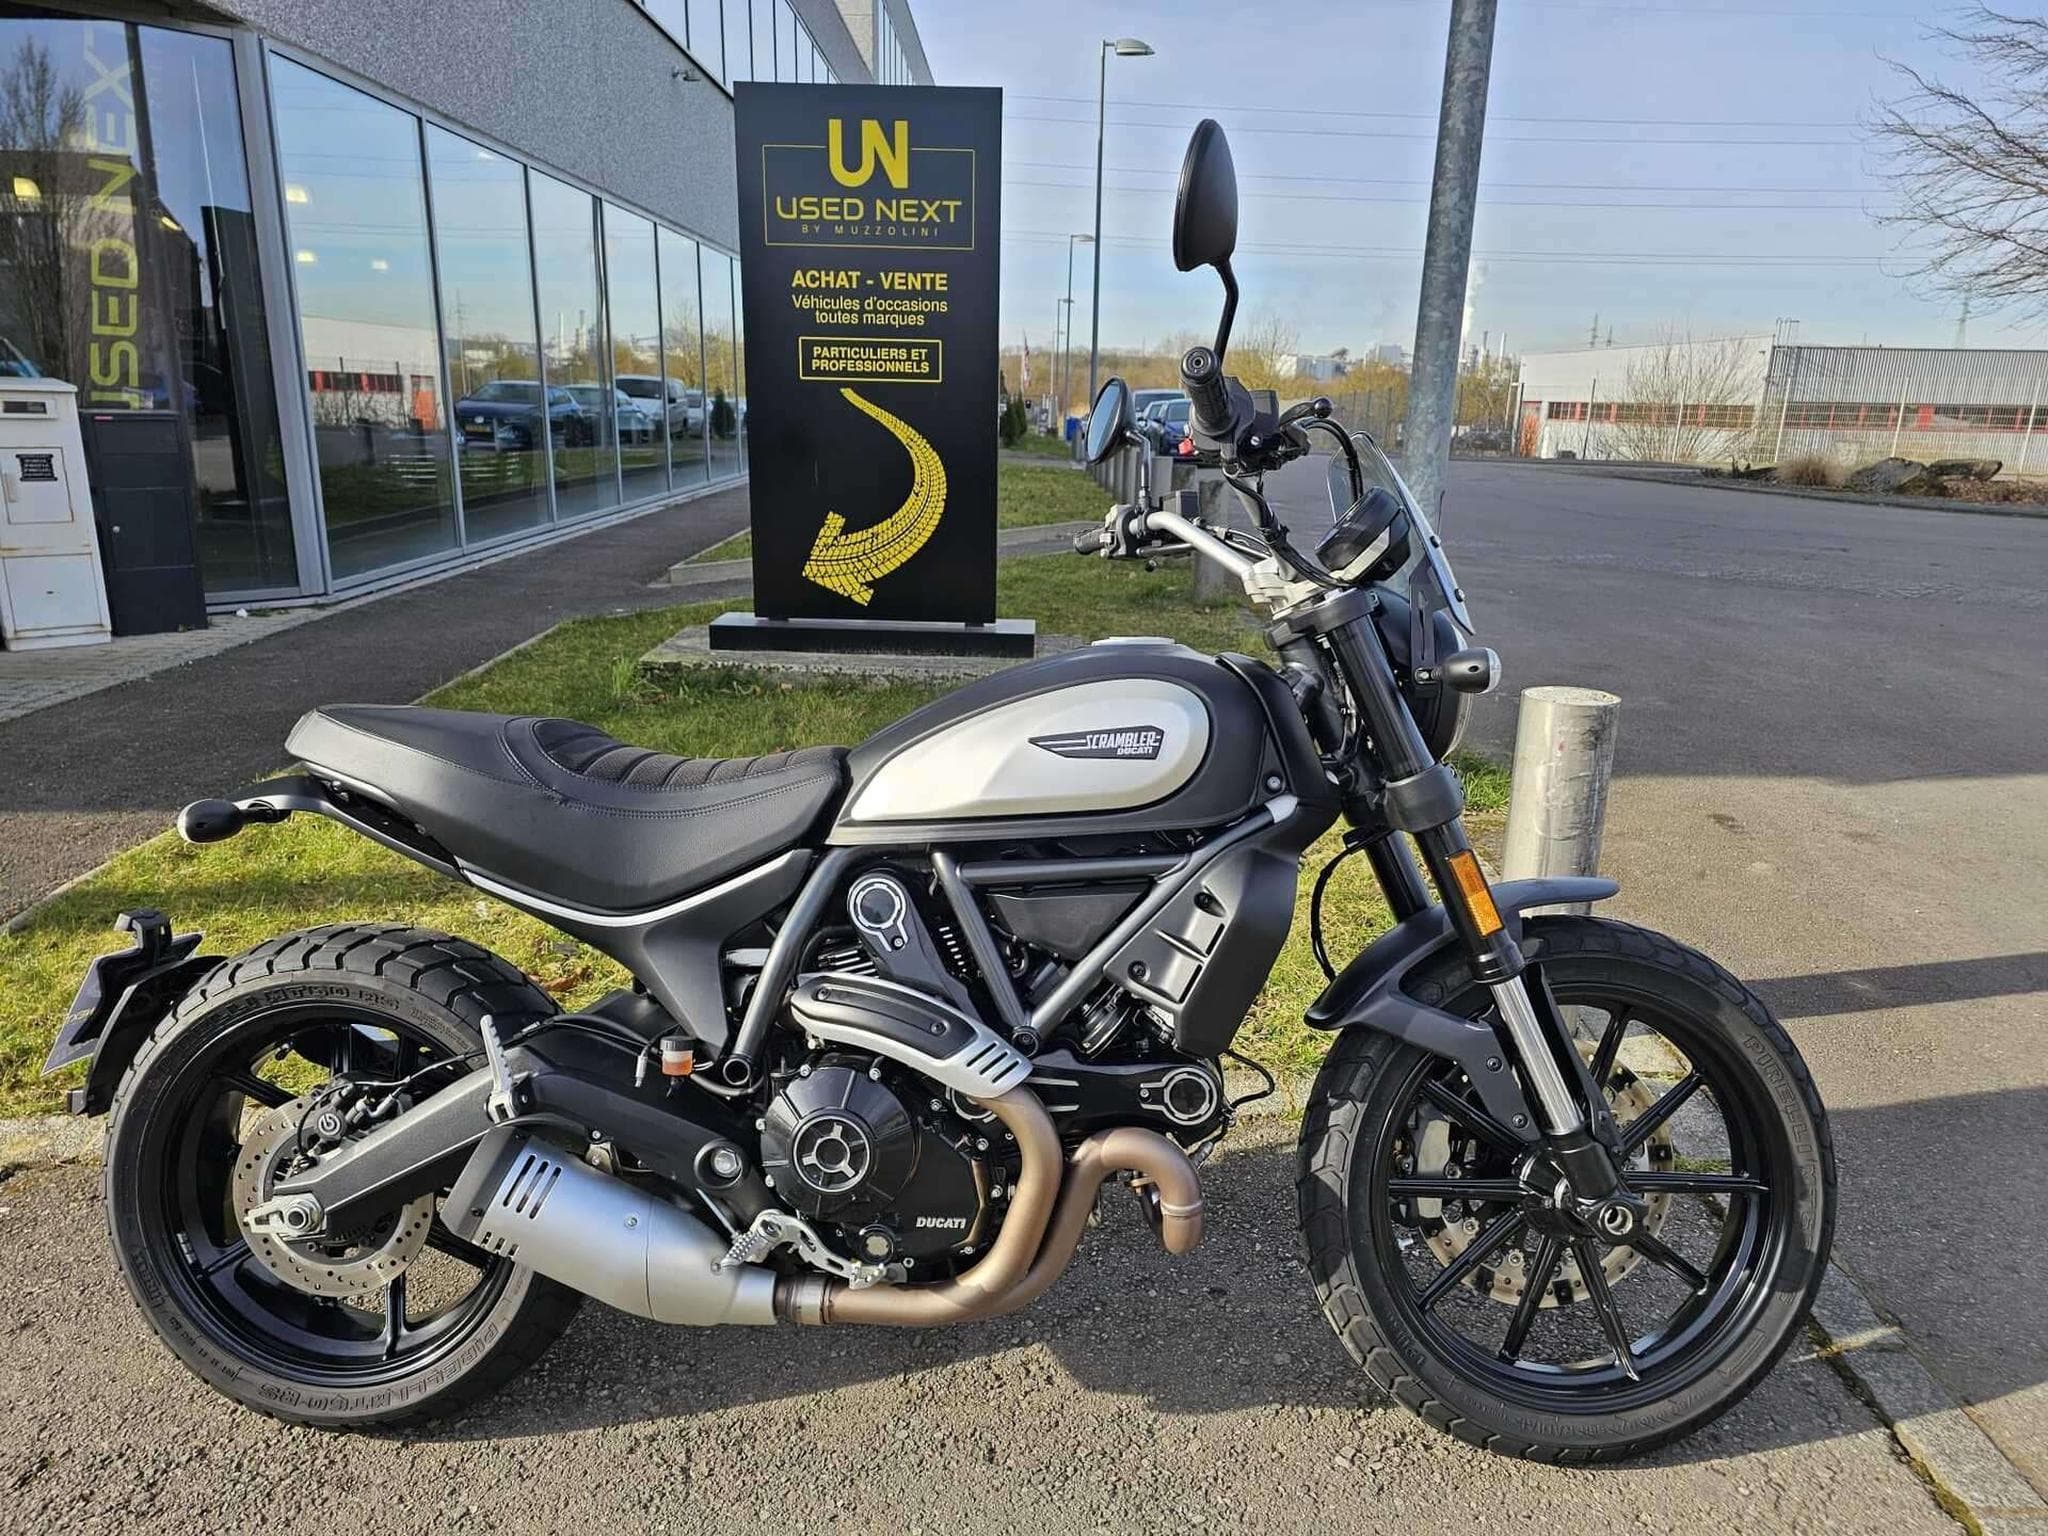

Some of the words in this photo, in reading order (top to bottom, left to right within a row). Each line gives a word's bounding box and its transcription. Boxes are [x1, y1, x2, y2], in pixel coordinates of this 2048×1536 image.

[828, 119, 909, 190] UN
[776, 196, 864, 220] USED
[876, 199, 963, 223] NEXT
[802, 223, 821, 234] BY
[834, 224, 939, 237] MUZZOLINI
[791, 270, 861, 289] ACHAT
[880, 272, 948, 291] VENTE
[792, 294, 861, 311] Véhicules
[864, 296, 948, 312] d'occasions
[815, 310, 859, 324] toutes
[863, 313, 925, 328] marques
[813, 346, 908, 360] PARTICULIERS
[911, 349, 928, 361] ET
[811, 359, 930, 373] PROFESSIONNELS
[1085, 731, 1158, 750] SCRAMBLER
[1117, 746, 1153, 756] DUCATI
[1744, 1035, 1818, 1154] PIRELLI
[916, 1216, 967, 1229] DUCATI
[399, 1320, 500, 1400] PIRELLI
